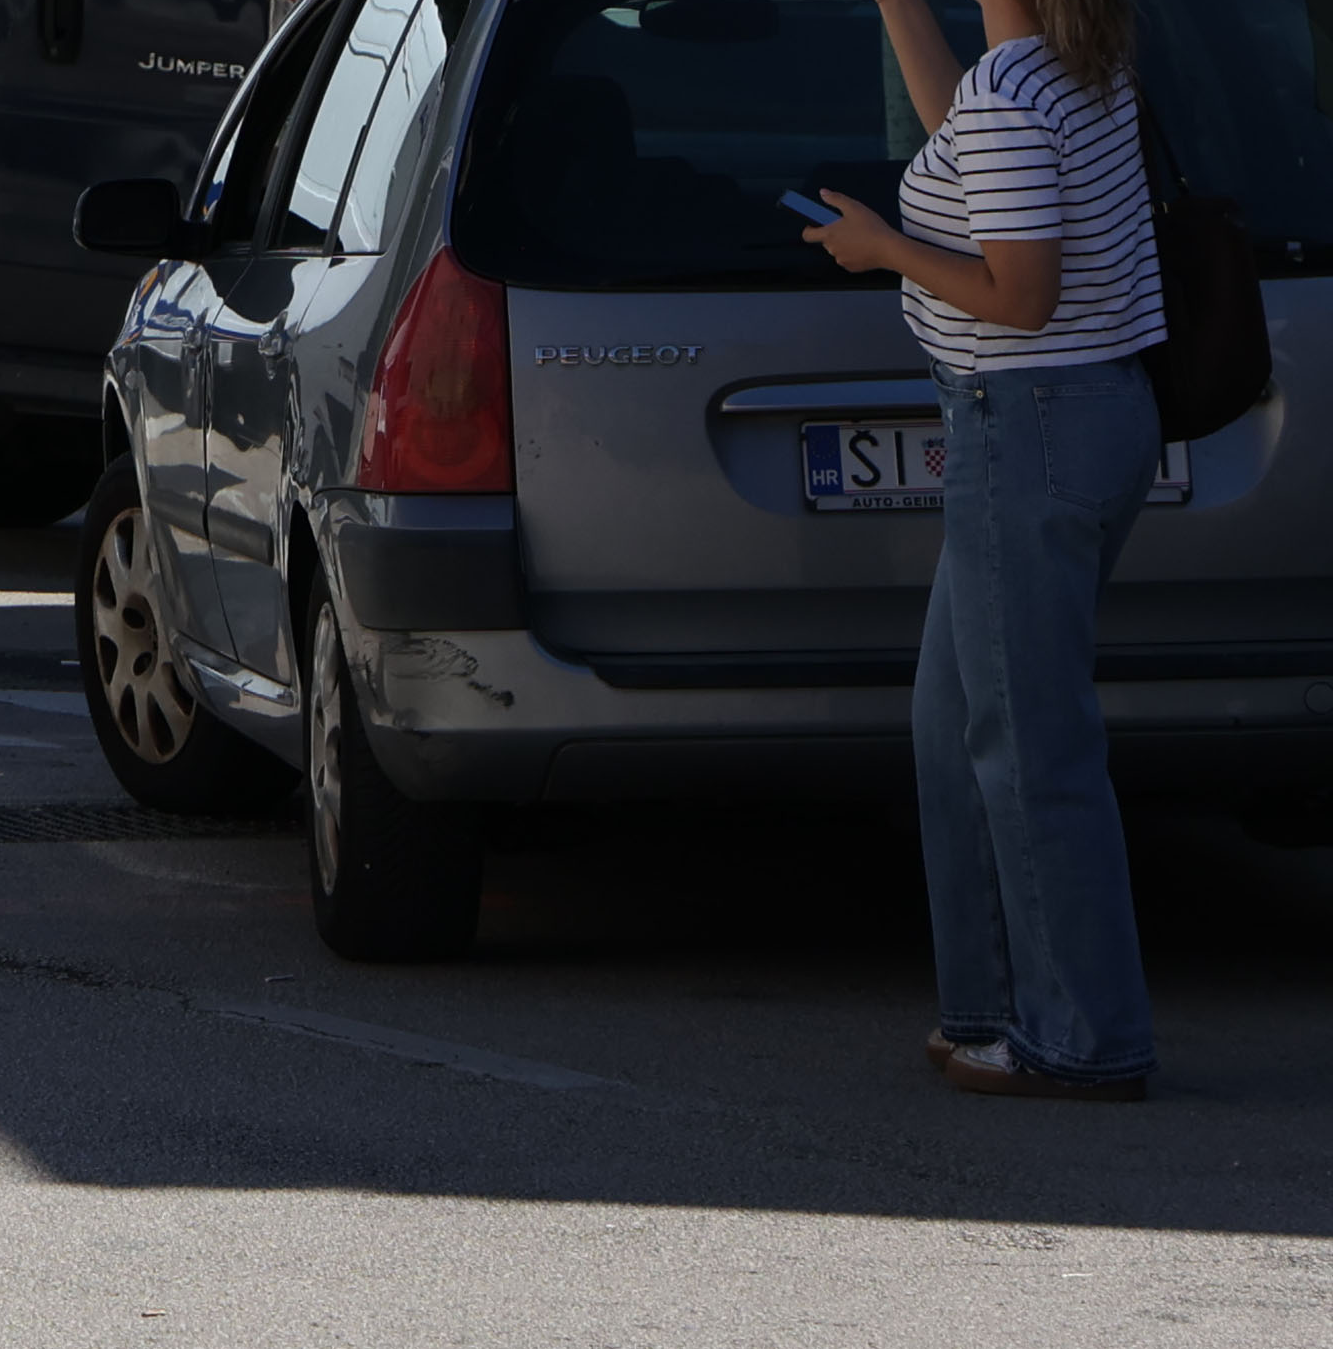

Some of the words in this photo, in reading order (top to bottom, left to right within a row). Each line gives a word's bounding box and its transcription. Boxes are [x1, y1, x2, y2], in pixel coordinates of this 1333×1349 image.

[138, 52, 245, 79] JUMPER
[535, 345, 703, 366] PEUGEOT
[812, 469, 839, 486] HR
[848, 429, 907, 488] ŠI
